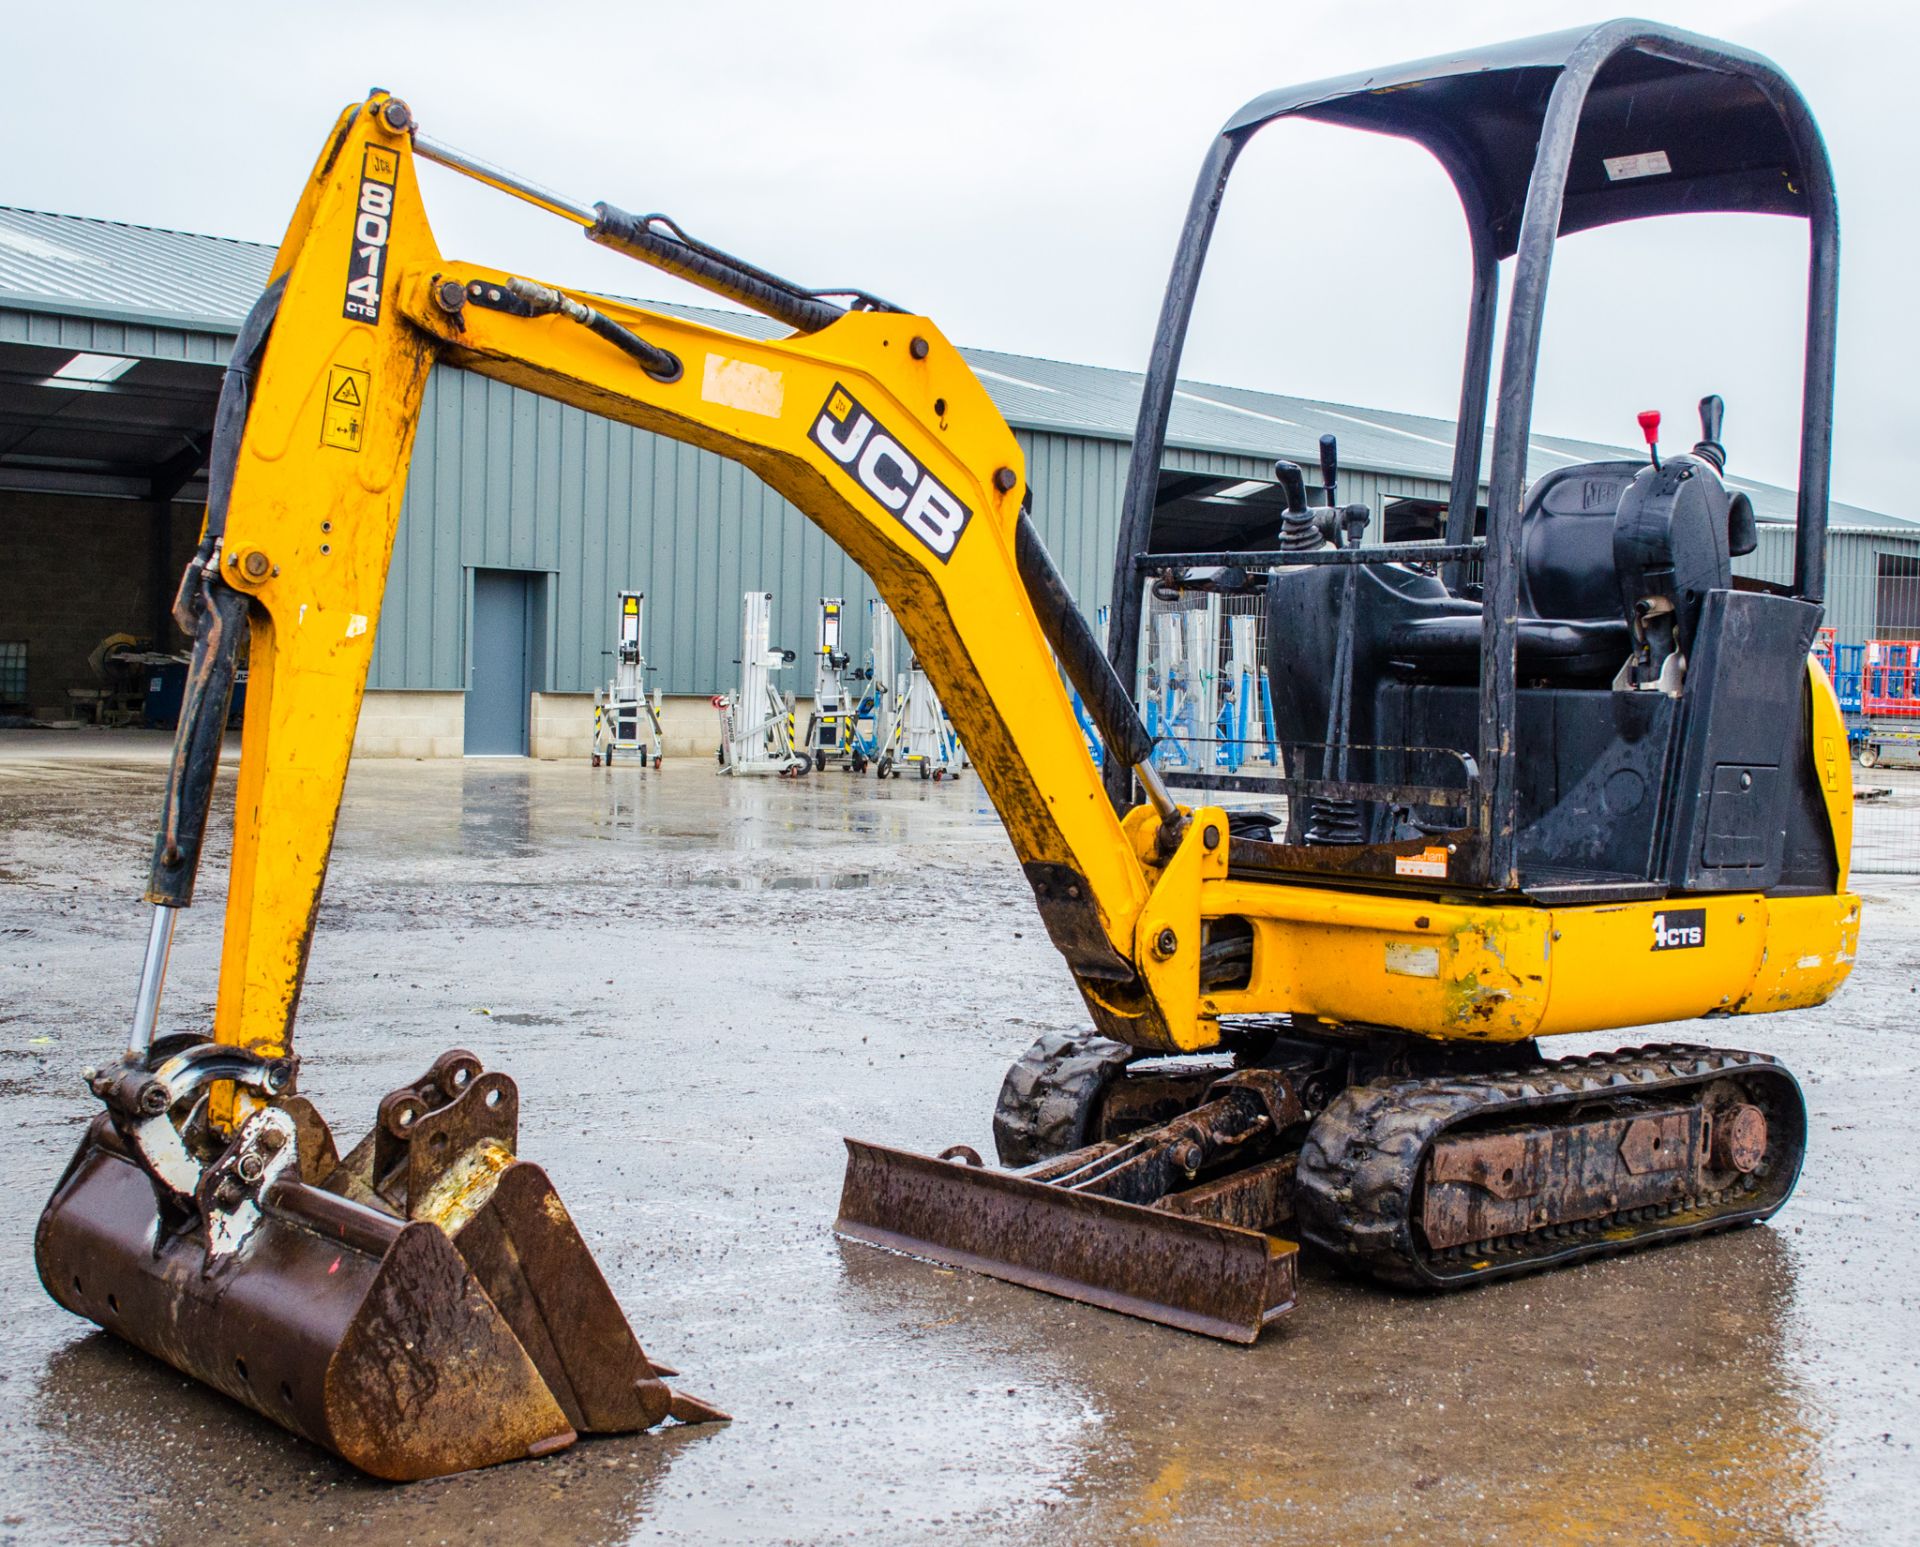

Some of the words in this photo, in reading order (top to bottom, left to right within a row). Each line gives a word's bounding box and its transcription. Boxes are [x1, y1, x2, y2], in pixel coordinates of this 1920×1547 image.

[348, 182, 393, 306] 8014
[346, 301, 377, 318] CTS
[816, 413, 964, 554] JCB
